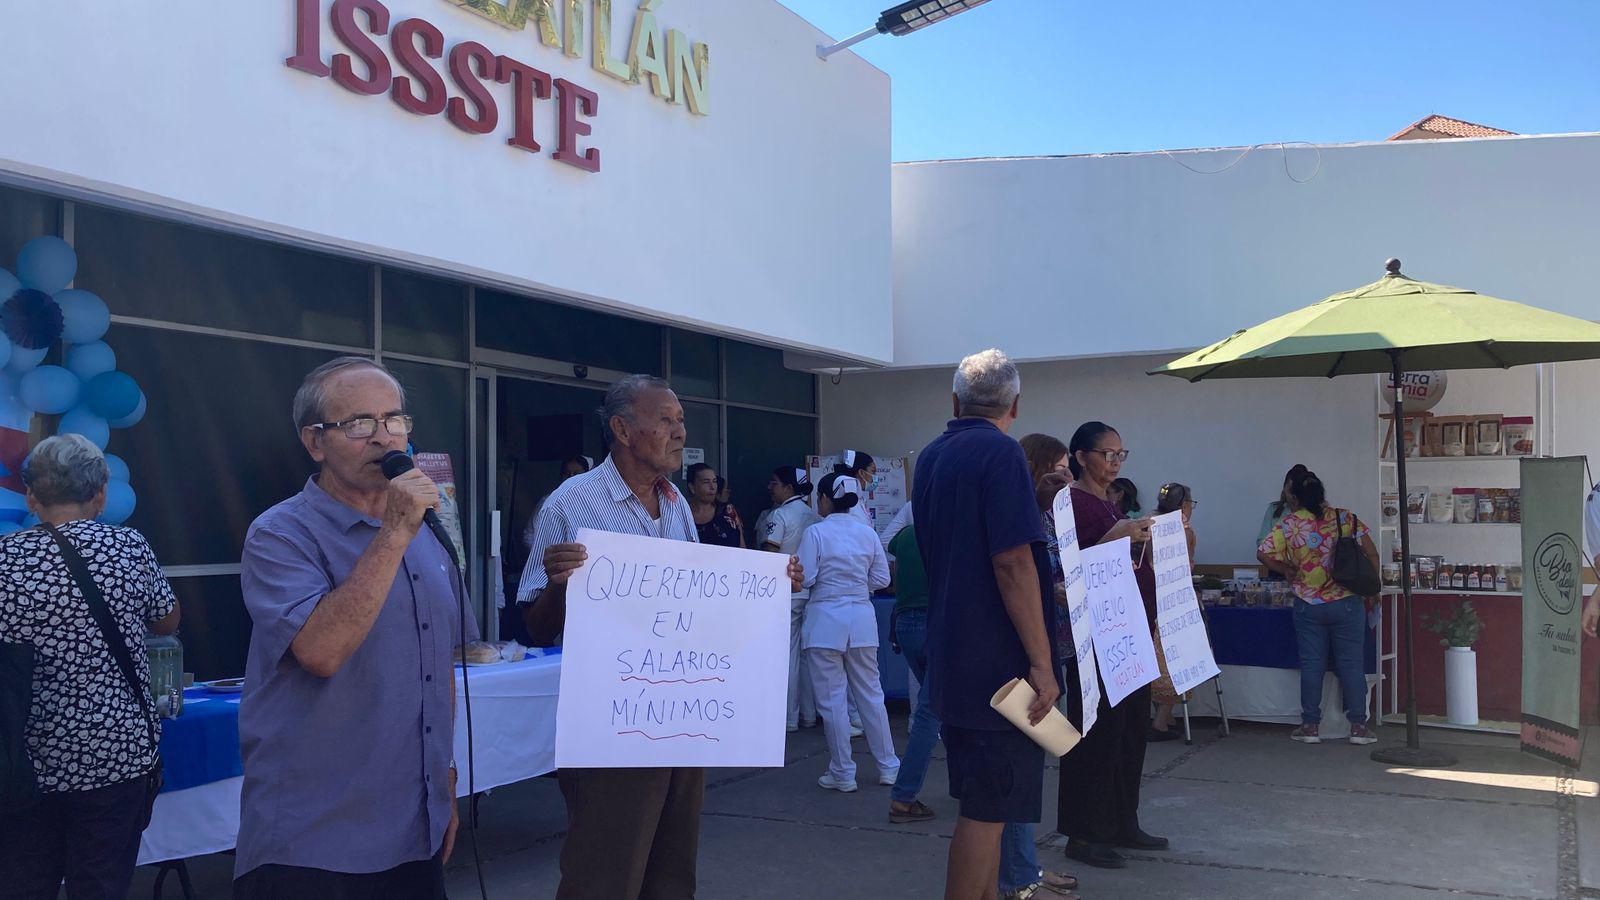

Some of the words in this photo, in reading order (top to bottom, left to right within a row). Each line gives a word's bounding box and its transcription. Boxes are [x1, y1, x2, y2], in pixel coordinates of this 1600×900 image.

[285, 0, 600, 172] ISSSTE
[418, 459, 448, 467] MELLITUS
[586, 555, 730, 601] QUEREMOS
[739, 570, 777, 600] PAGO
[1083, 558, 1123, 590] UEREMOS
[1540, 543, 1572, 581] Bio
[652, 611, 693, 638] EN
[1091, 595, 1126, 628] NUEVO
[1539, 623, 1554, 640] Tu
[616, 649, 732, 675] SALARIOS
[1103, 635, 1138, 675] ISSSTE
[611, 688, 735, 726] MÍNIMOS
